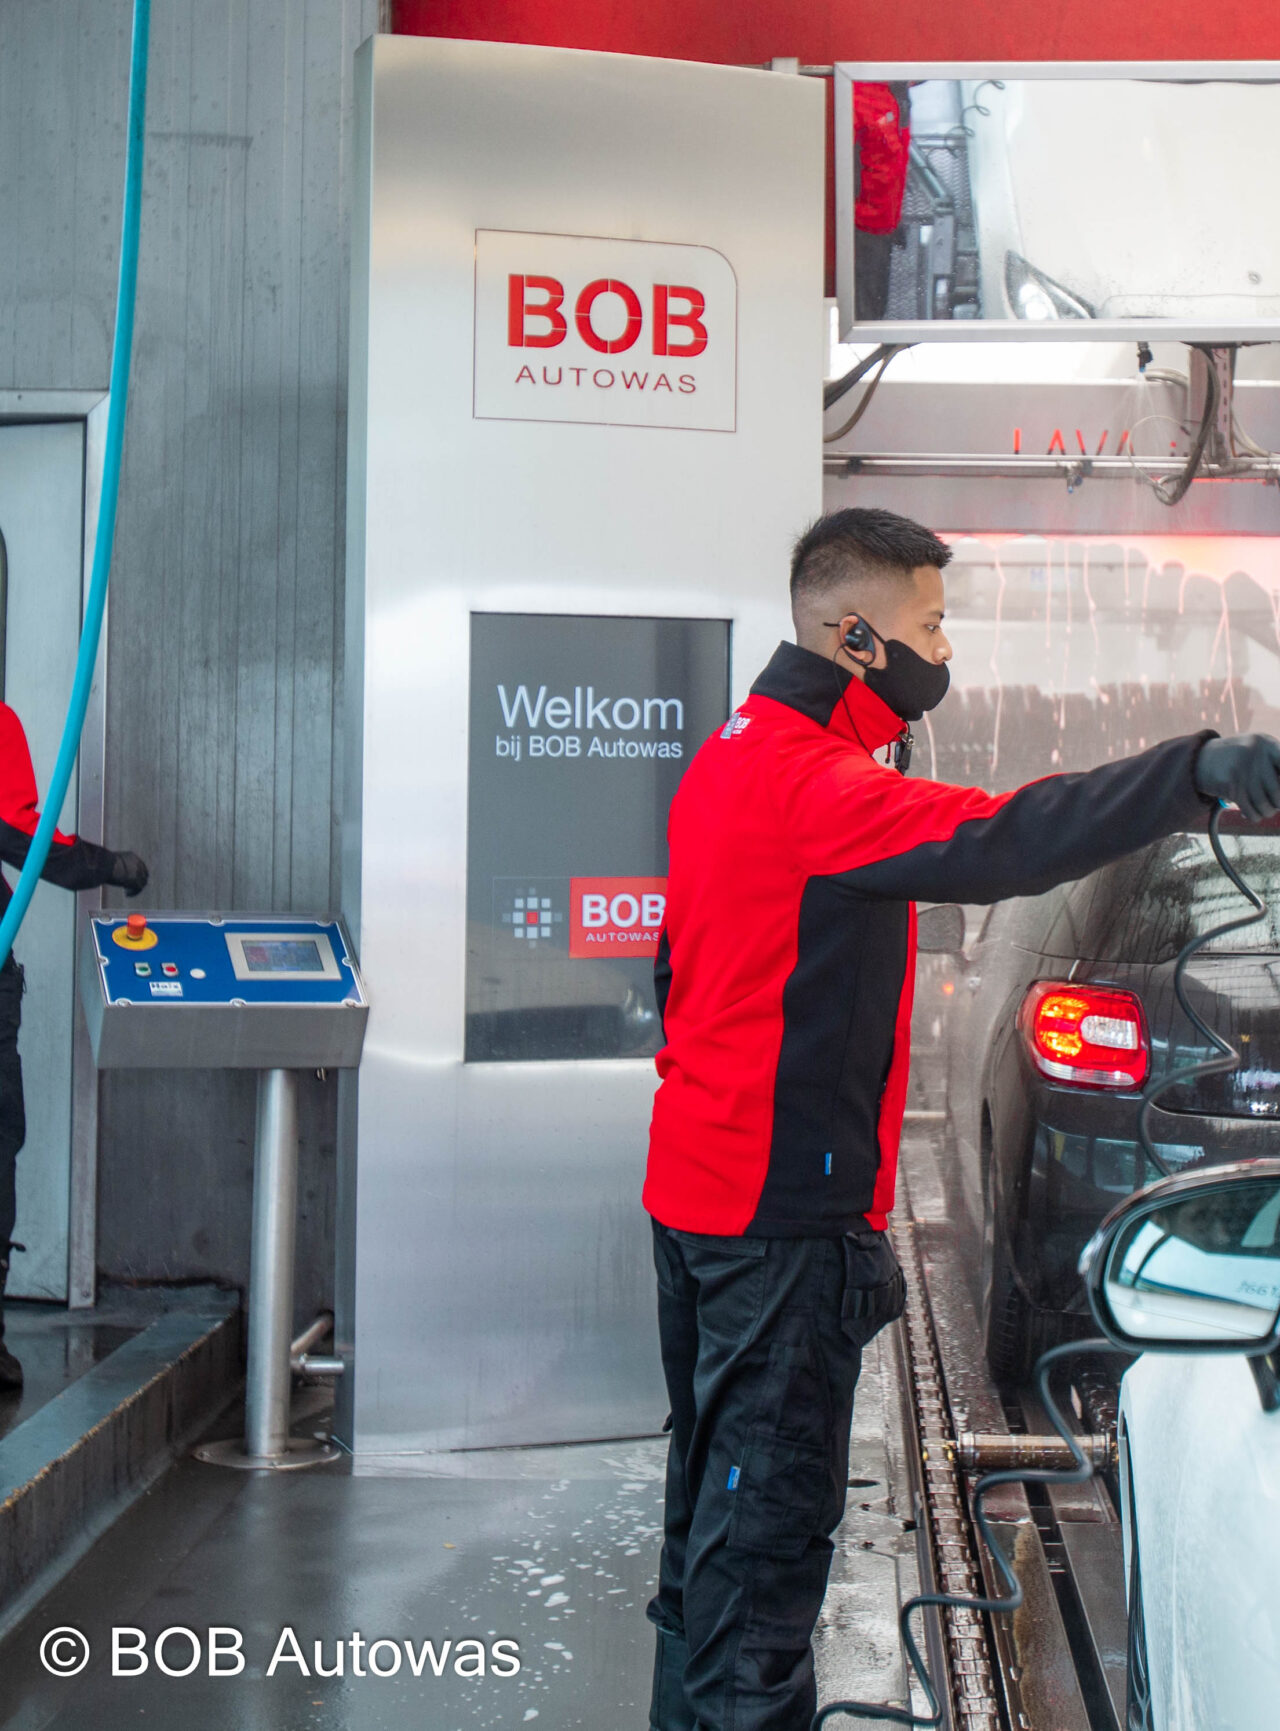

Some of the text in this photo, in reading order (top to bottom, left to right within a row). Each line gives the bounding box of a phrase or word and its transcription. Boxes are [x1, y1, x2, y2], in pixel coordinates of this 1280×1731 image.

[507, 273, 709, 358] BOB
[515, 365, 697, 394] AUTOWAS
[497, 685, 684, 730] Welkom
[496, 735, 683, 761] bij BOB Autowas
[581, 893, 667, 928] BOB
[585, 932, 660, 943] AUTOWAS
